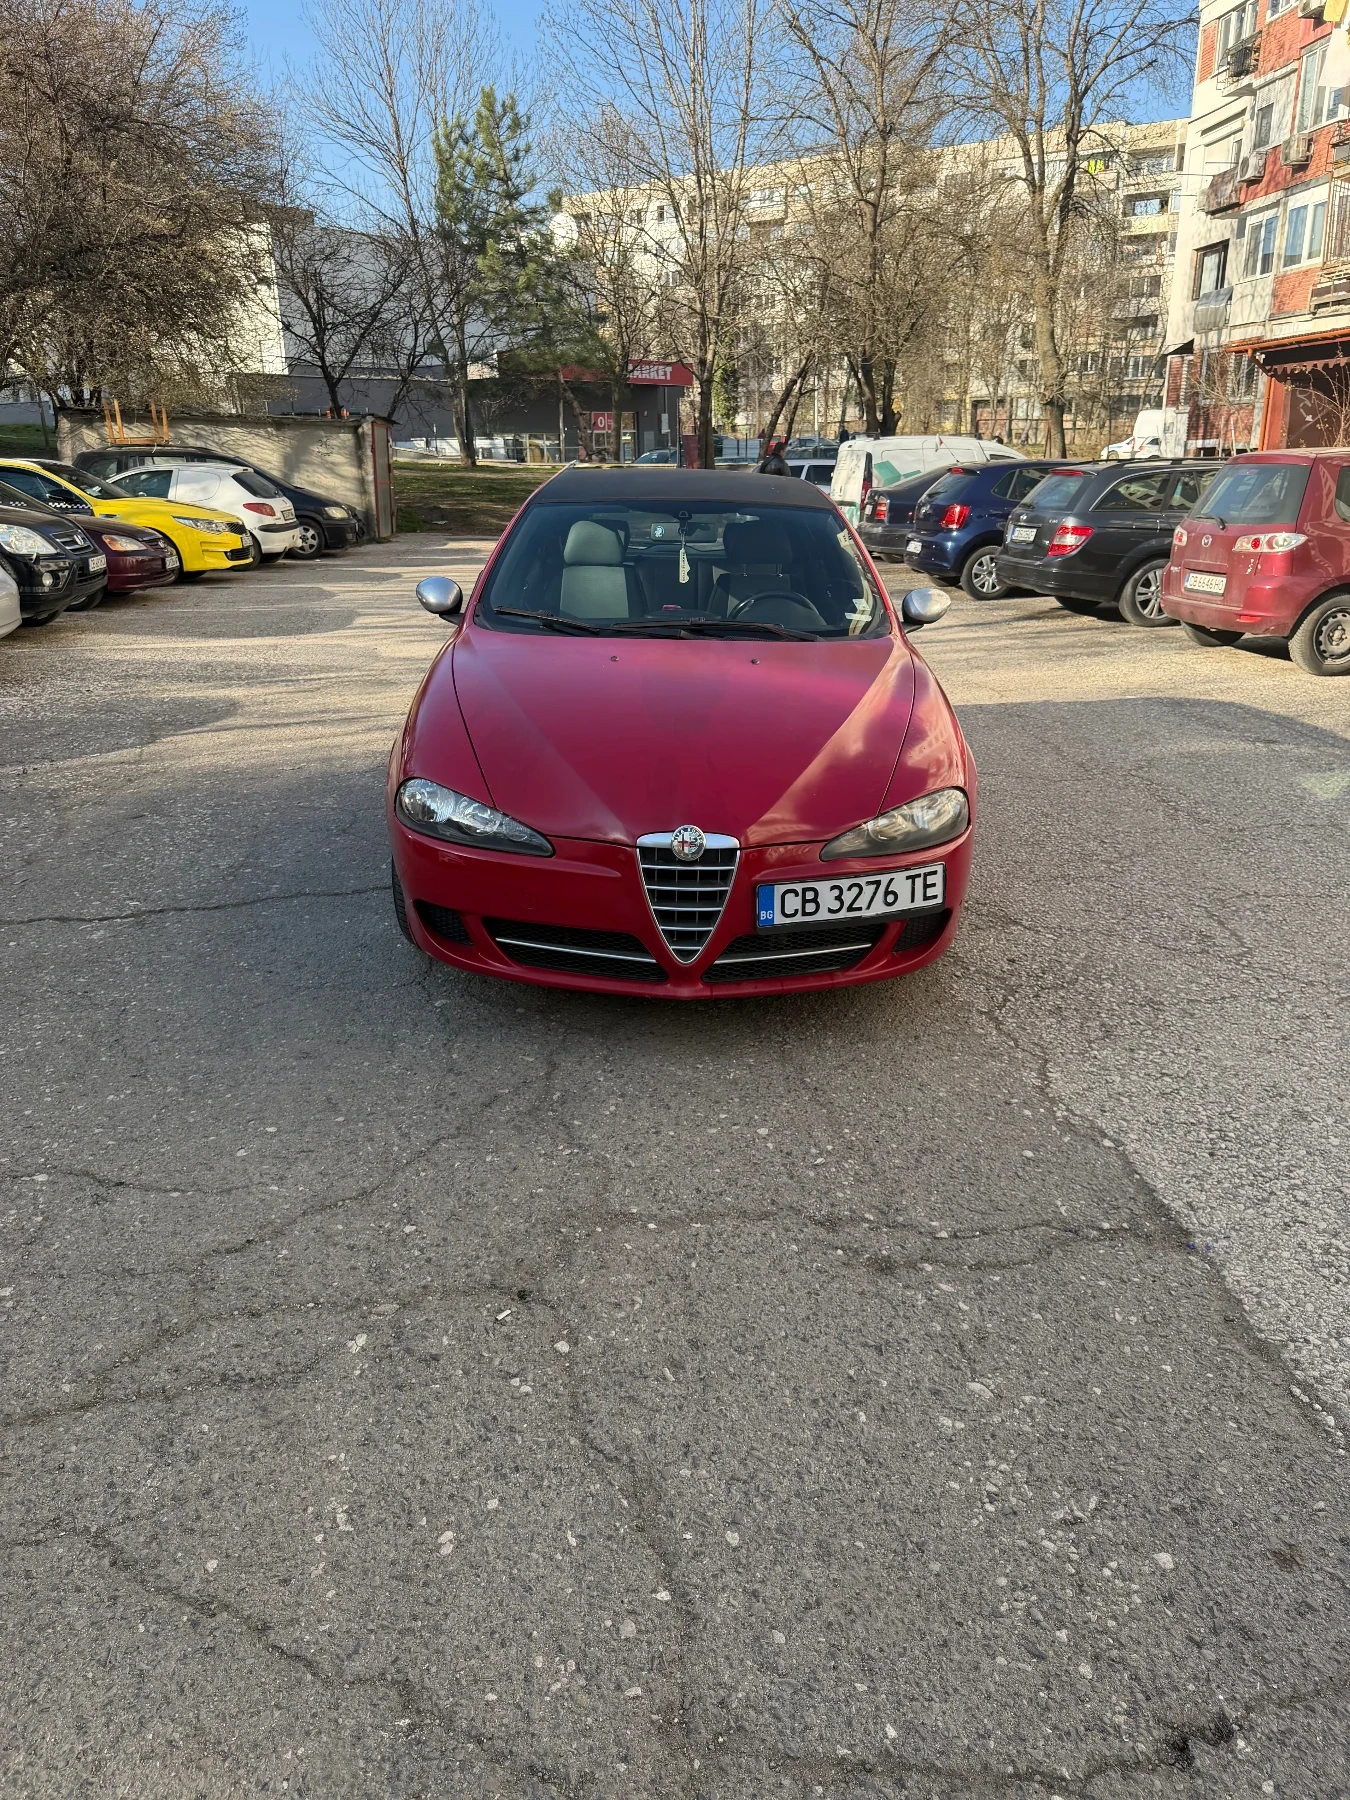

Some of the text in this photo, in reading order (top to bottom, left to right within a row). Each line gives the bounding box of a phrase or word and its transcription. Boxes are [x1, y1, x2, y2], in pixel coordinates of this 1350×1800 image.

[780, 870, 938, 918] CB 3276 TE
[760, 910, 773, 920] BG
